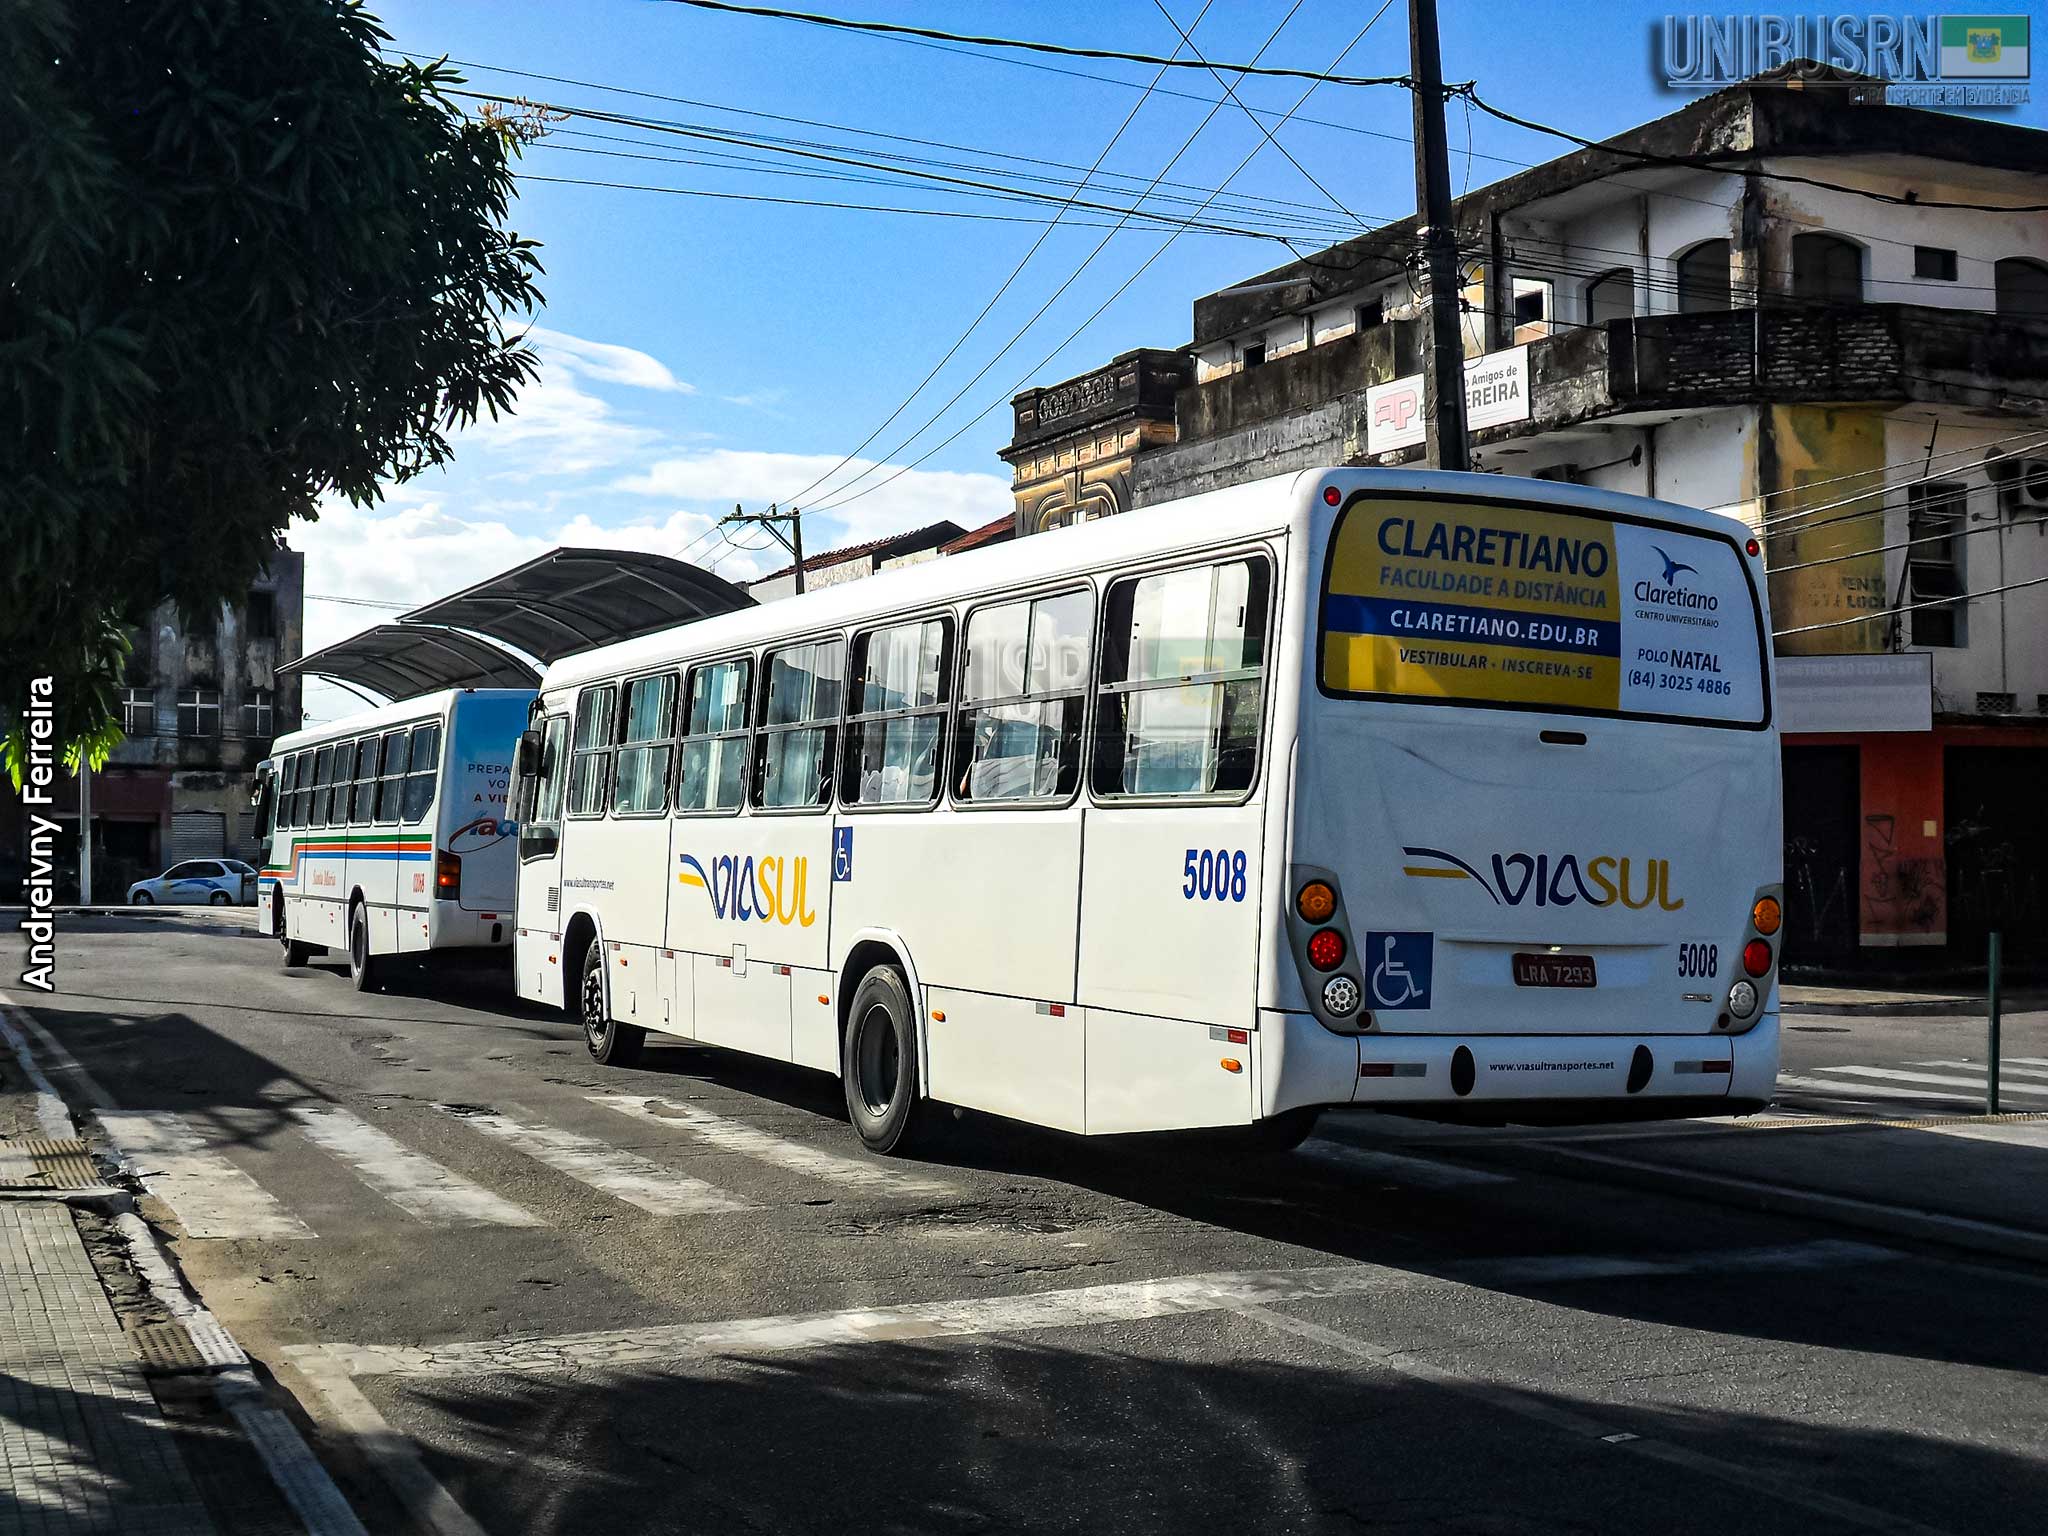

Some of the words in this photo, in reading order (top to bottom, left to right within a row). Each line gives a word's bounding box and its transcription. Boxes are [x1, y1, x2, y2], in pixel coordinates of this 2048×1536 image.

[1472, 370, 1504, 386] Amigos
[1506, 365, 1518, 377] de
[1377, 518, 1609, 578] CLARETIANO
[1379, 566, 1494, 596] FACULDADE
[1515, 580, 1607, 609] DISTÂNCIA
[1634, 581, 1719, 611] Claretiano
[1390, 610, 1599, 647] CLARETIANO.EDU.BR
[1635, 609, 1665, 623] CENTRO
[1400, 648, 1488, 670] VESTIBULAR
[1502, 658, 1592, 680] INSCREVA-SE
[1638, 648, 1668, 665] POLO
[1670, 649, 1721, 673] NATAL
[1628, 669, 1656, 689] (84)
[1659, 673, 1693, 692] 3025
[1697, 677, 1731, 696] 4886
[488, 779, 510, 789] VO
[712, 855, 815, 927] VIASUL
[1183, 849, 1246, 902] 5008
[1491, 852, 1685, 912] VIASUL
[1520, 964, 1549, 983] LRA
[1553, 966, 1593, 983] 7293
[1678, 943, 1718, 978] 5008
[1489, 1061, 1615, 1073] www.viasultransportes.net
